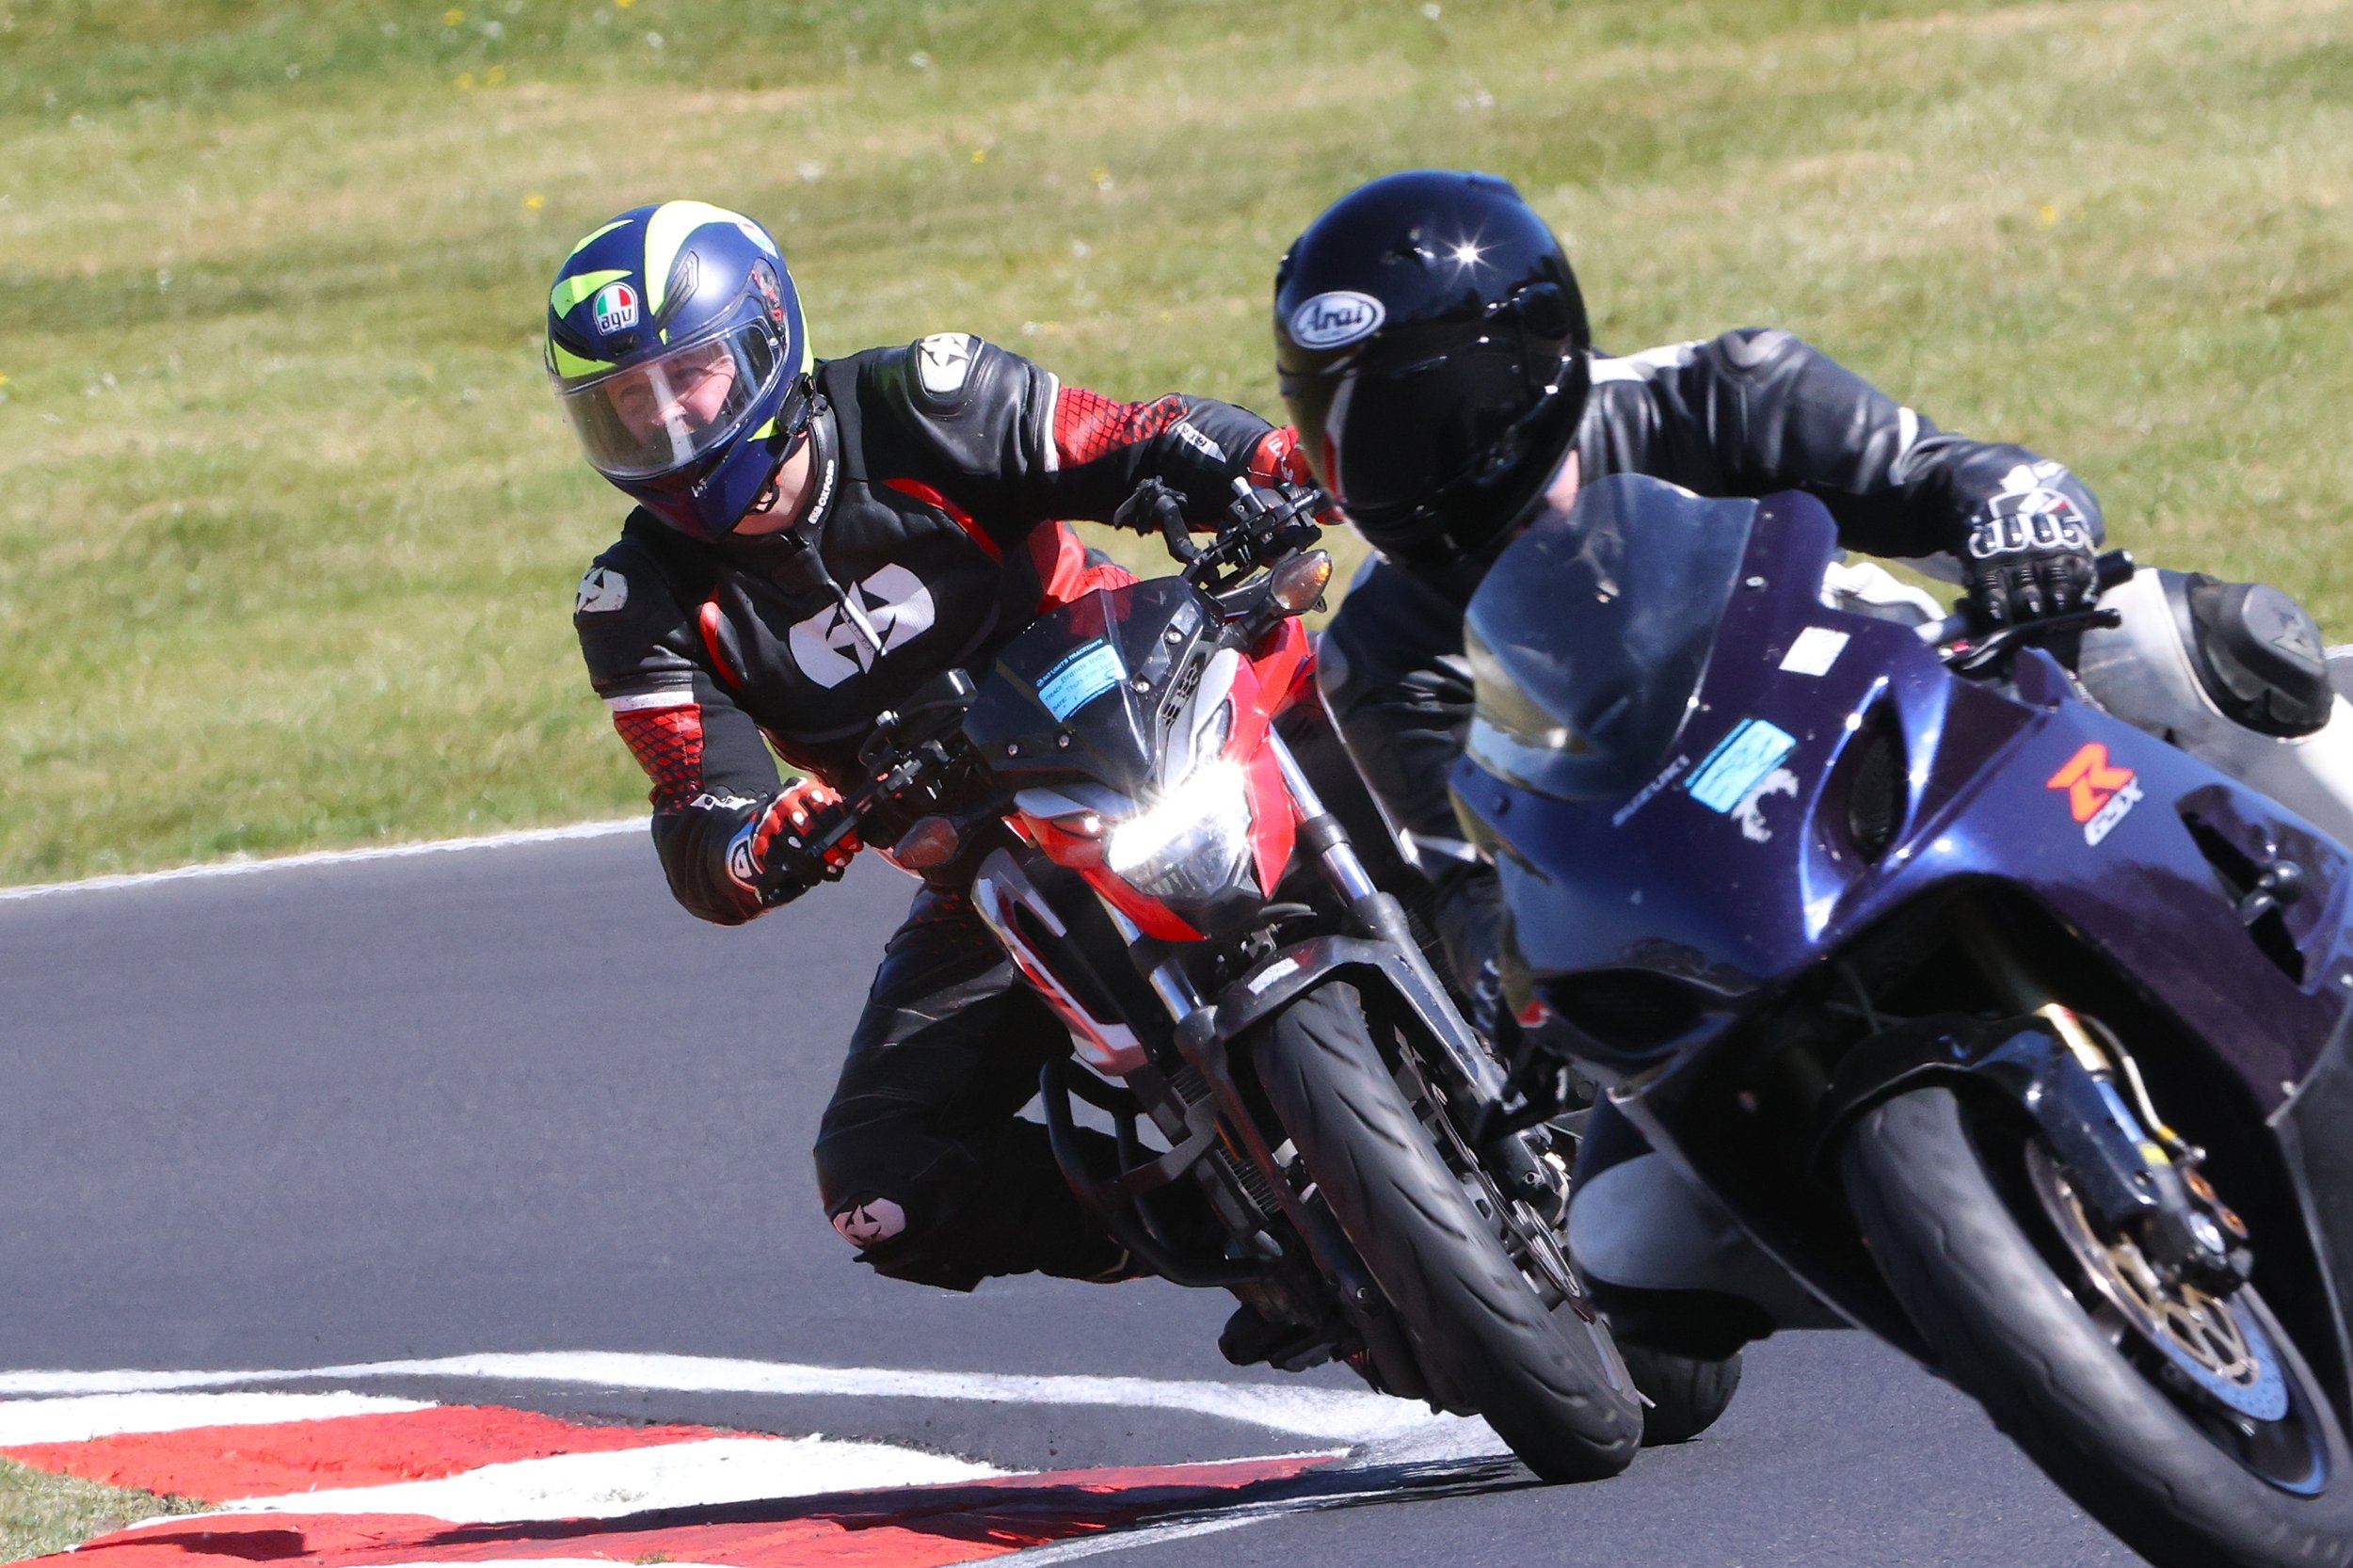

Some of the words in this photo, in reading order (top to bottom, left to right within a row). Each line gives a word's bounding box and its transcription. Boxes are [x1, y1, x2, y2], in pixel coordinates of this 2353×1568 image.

[600, 308, 632, 330] agv
[1304, 302, 1363, 332] Arai
[817, 458, 835, 508] OXFORD
[2083, 775, 2145, 846] GSX
